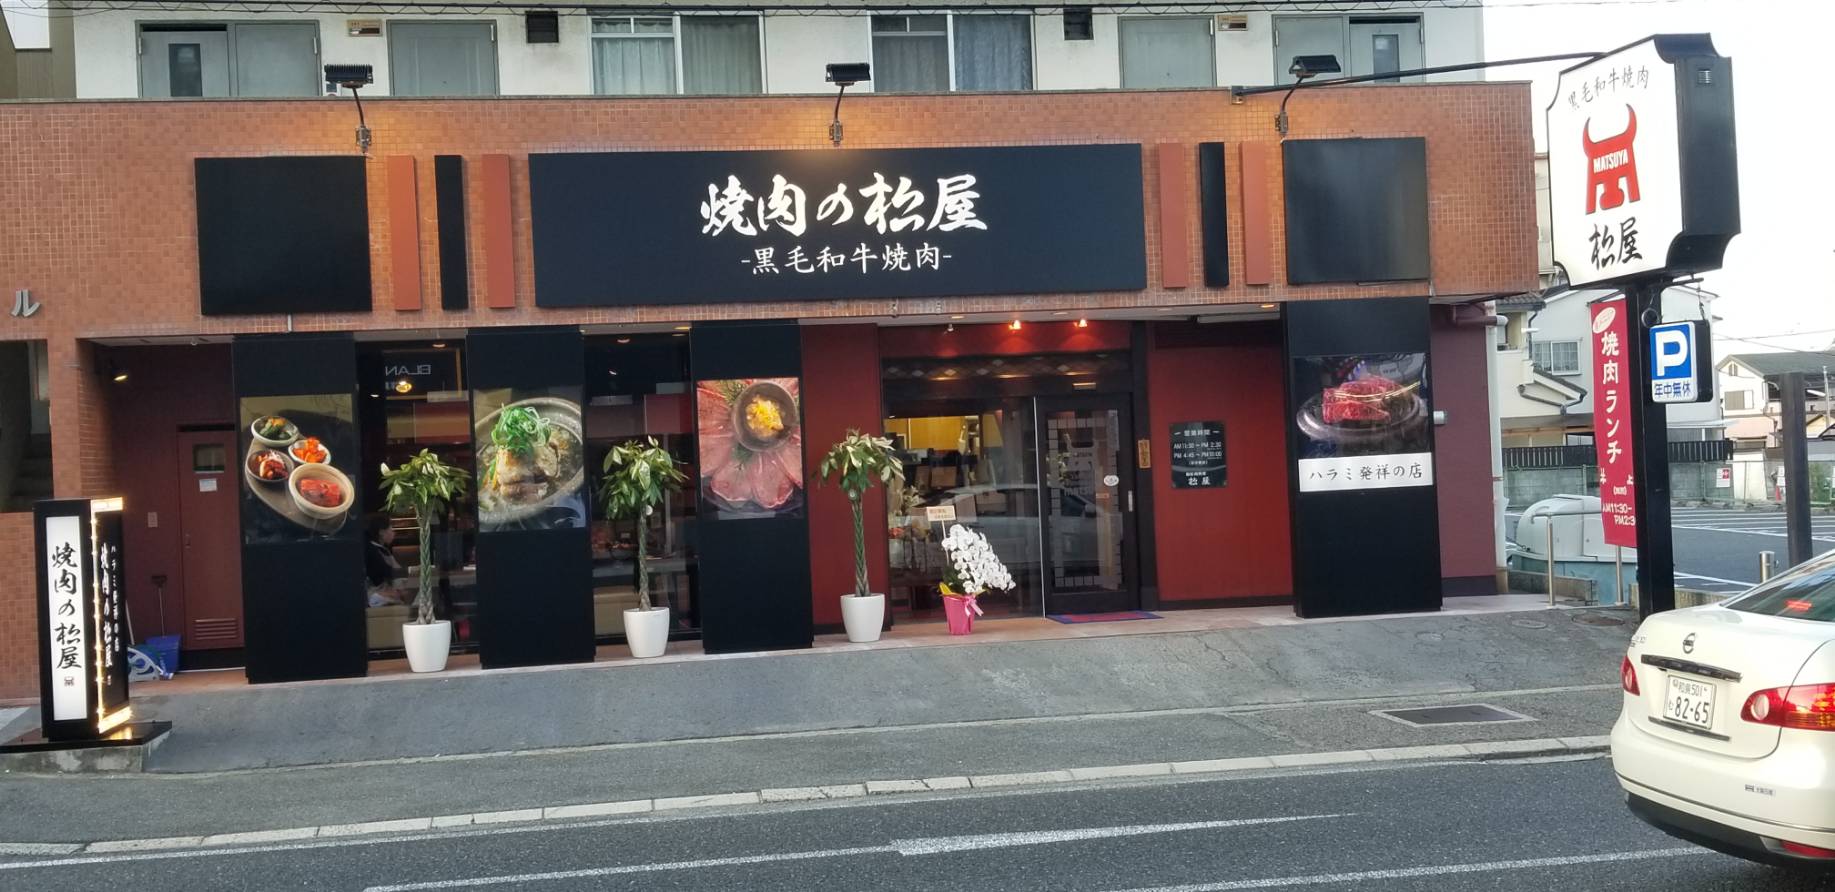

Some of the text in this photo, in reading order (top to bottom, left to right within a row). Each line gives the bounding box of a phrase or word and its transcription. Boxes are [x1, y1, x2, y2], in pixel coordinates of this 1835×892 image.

[1568, 65, 1649, 110] 黒毛和牛焼肉
[1593, 149, 1629, 173] MATSUYA
[11, 289, 41, 317] ル
[1655, 330, 1688, 376] P
[1601, 331, 1622, 464] 焼肉ランチ
[1654, 381, 1691, 398] 年中無休
[1310, 462, 1422, 481] ハラミ発祥の店
[1614, 514, 1635, 526] PM2:3
